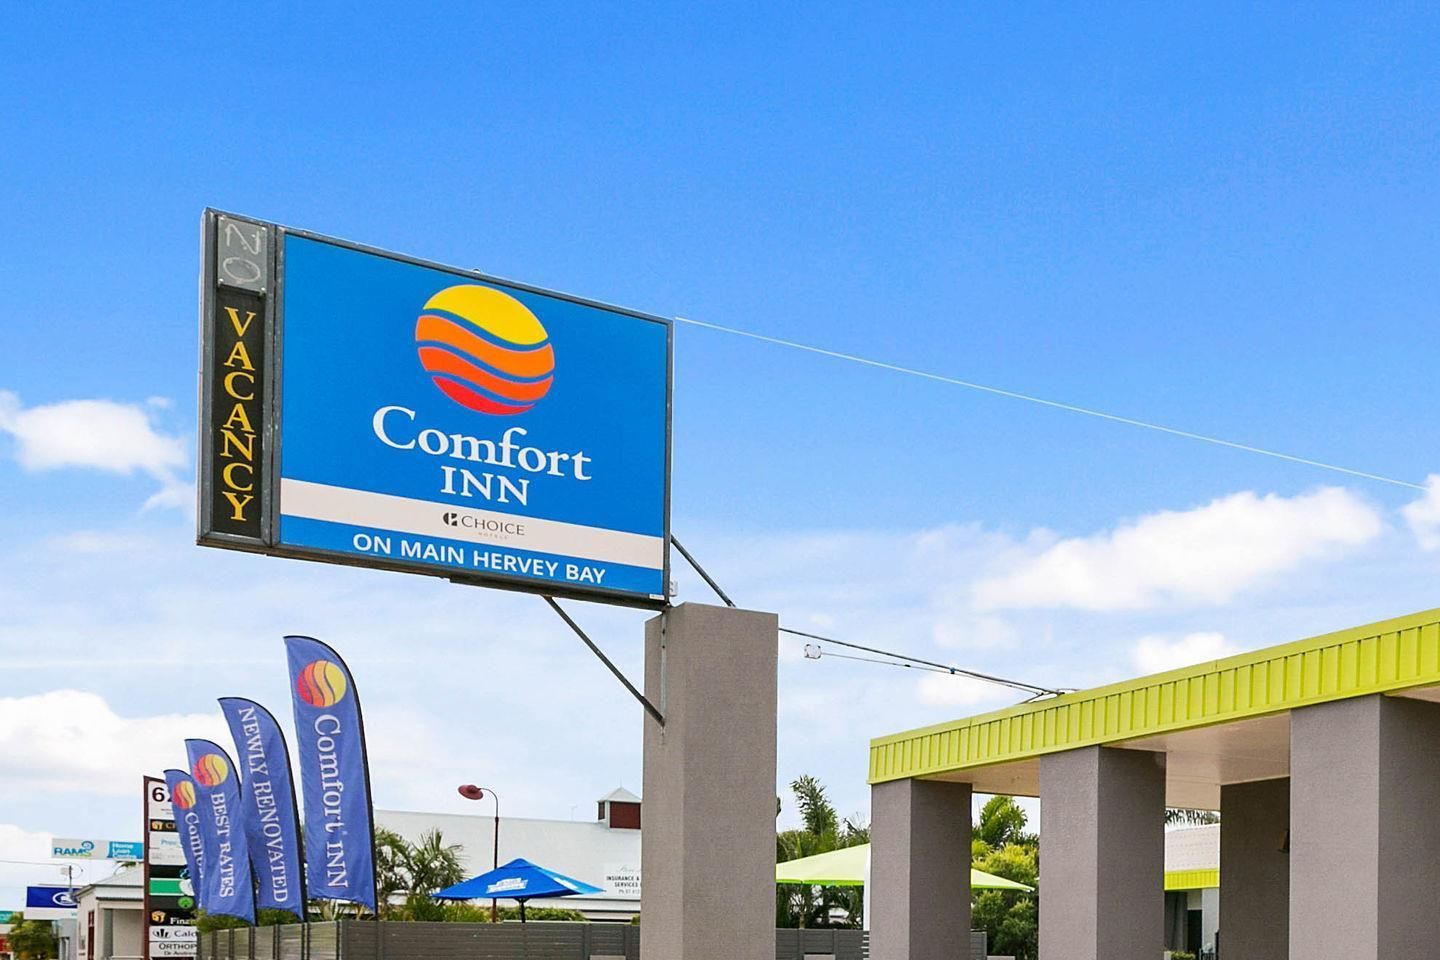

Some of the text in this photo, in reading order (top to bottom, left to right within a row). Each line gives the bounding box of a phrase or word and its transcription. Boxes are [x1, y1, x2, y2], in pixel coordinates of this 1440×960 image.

[220, 222, 261, 522] NO VACANCY
[372, 405, 593, 481] Comfort
[440, 465, 530, 507] INN
[352, 533, 606, 584] ON MAIN HERVEY BAY
[461, 514, 526, 537] CHOICE
[211, 791, 235, 898] BEST RATES
[238, 706, 289, 903] NEWLY RENOVATED
[314, 714, 349, 888] Comfort INN
